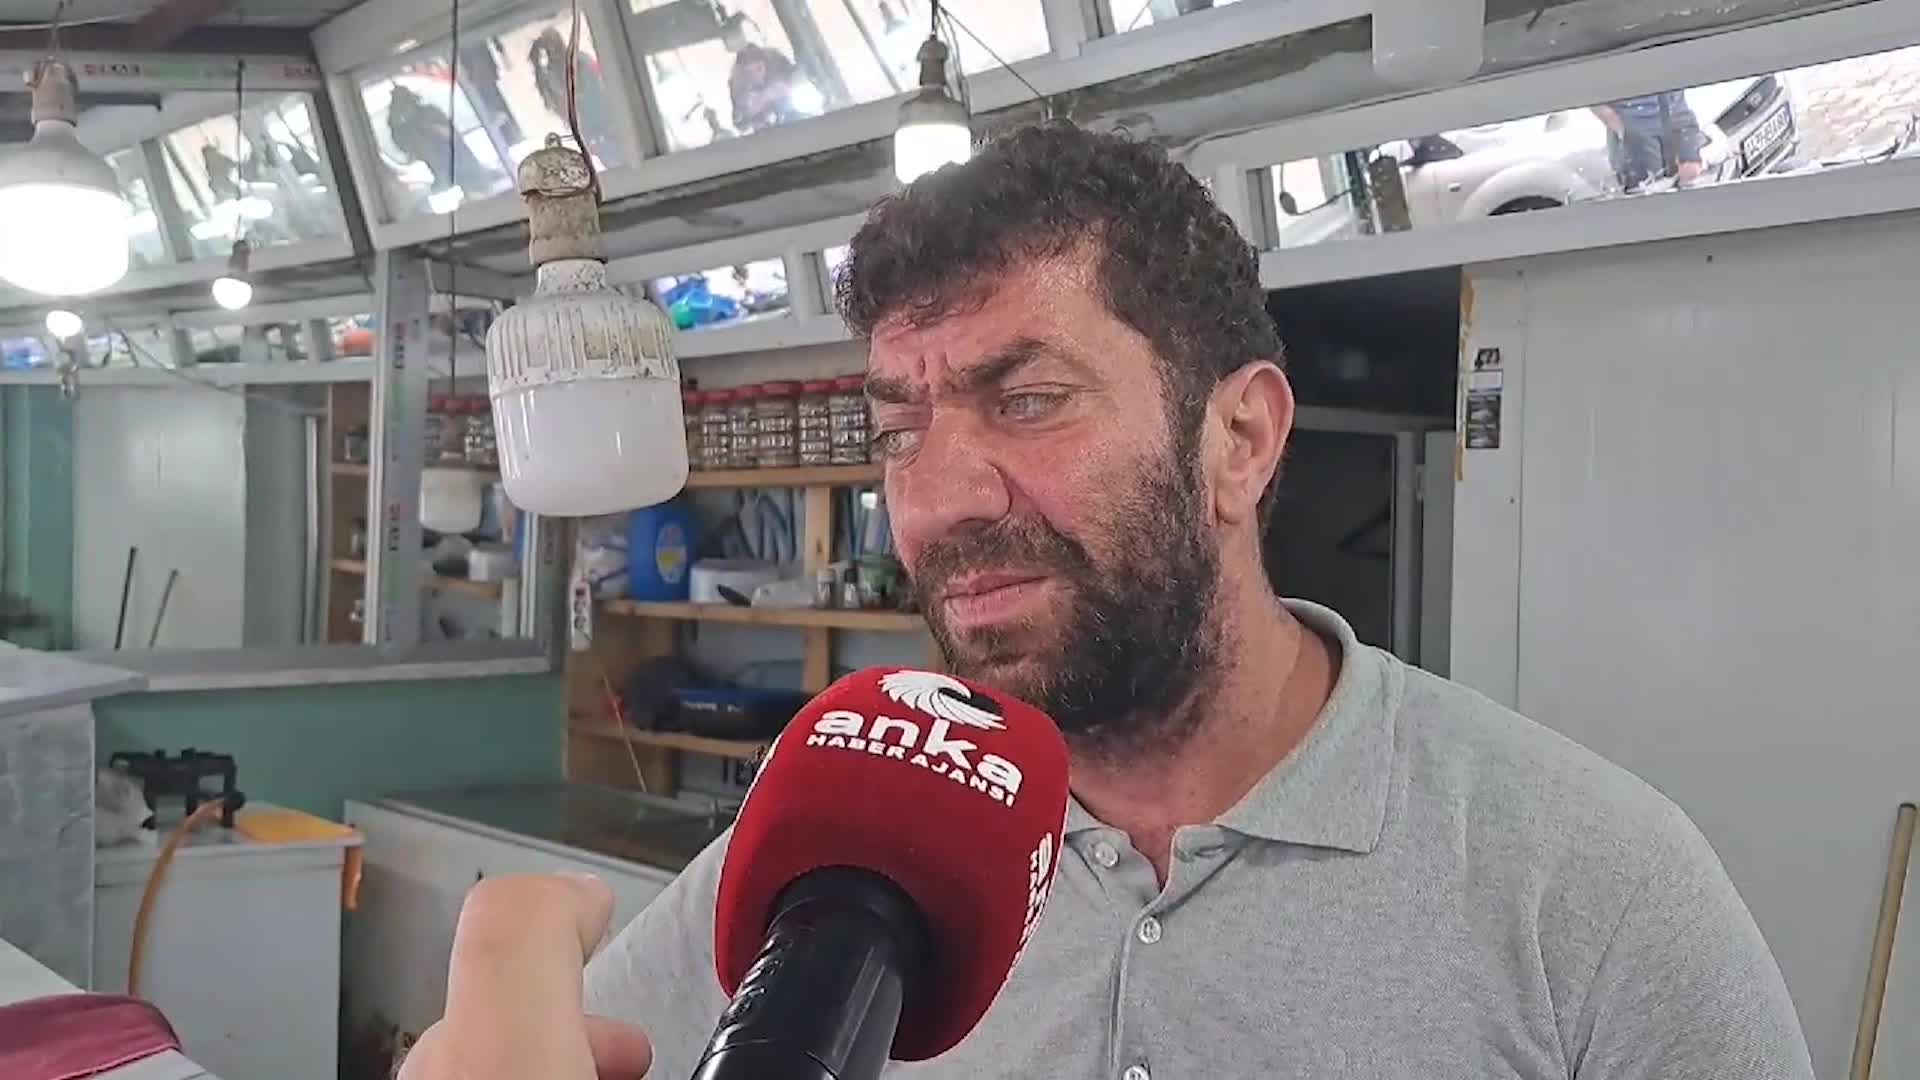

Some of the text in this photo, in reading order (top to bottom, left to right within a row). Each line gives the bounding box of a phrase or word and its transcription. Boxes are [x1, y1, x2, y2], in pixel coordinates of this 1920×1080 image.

[805, 733, 1015, 807] HABER AJANSI
[813, 710, 1023, 795] anka
